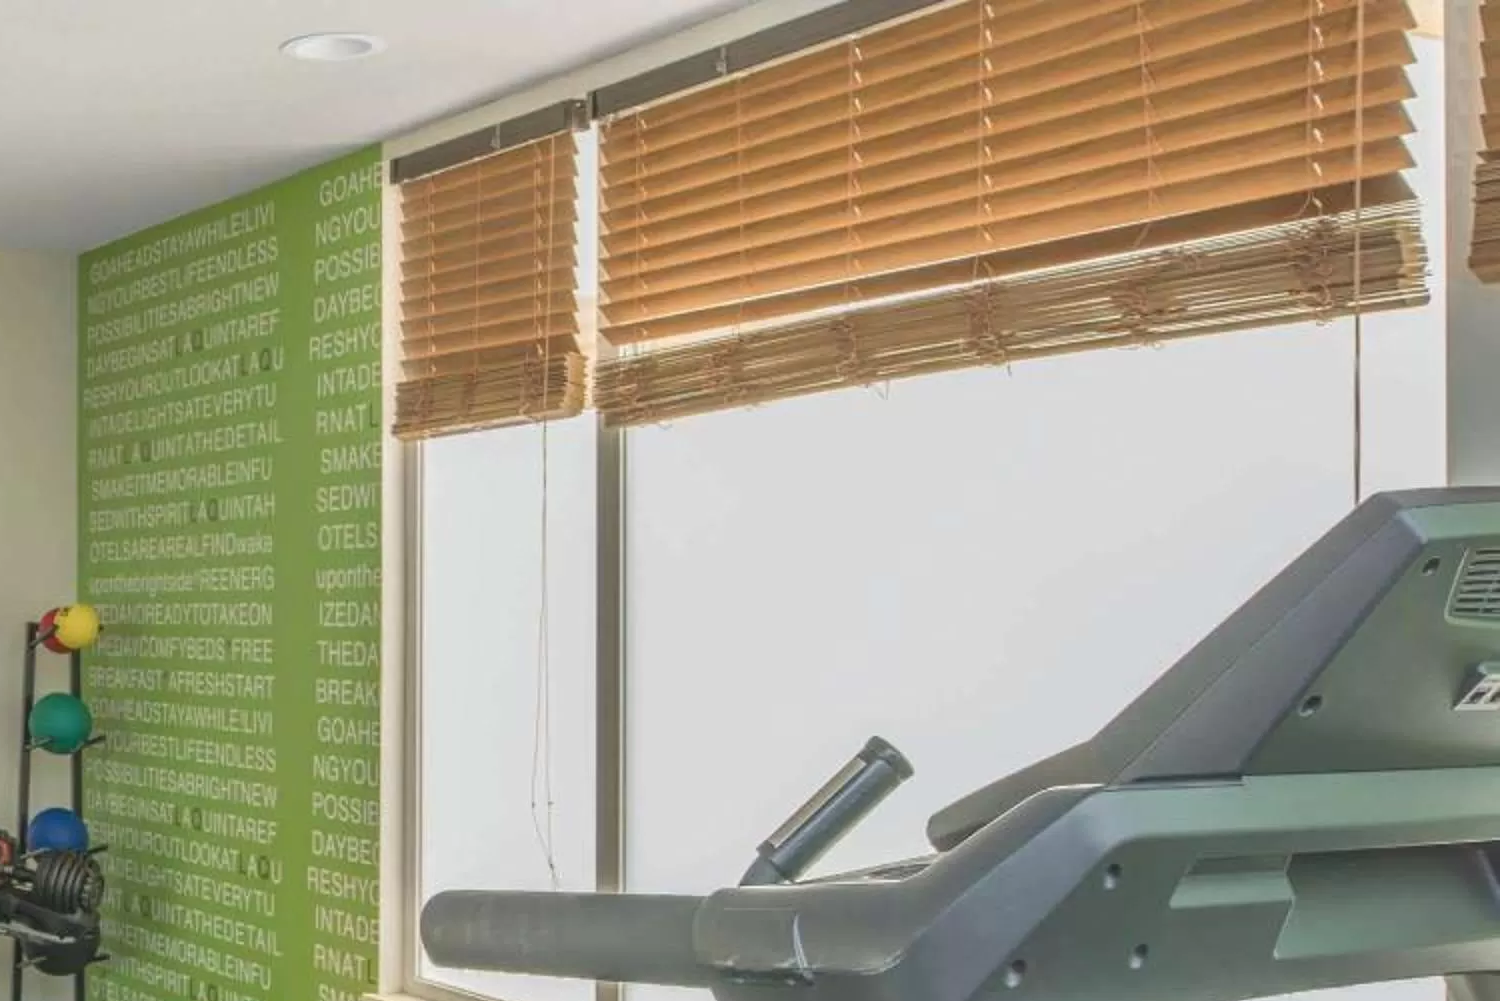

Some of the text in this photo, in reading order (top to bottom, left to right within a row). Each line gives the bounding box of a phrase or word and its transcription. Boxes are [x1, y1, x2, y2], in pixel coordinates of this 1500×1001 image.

[315, 204, 380, 248] NGYOU
[314, 242, 380, 285] POSSIB
[316, 362, 381, 400] INTADE
[320, 442, 382, 475] SMAKE
[317, 522, 377, 551] OTELS
[316, 640, 380, 667] THEDA
[313, 754, 380, 788] NGYOU
